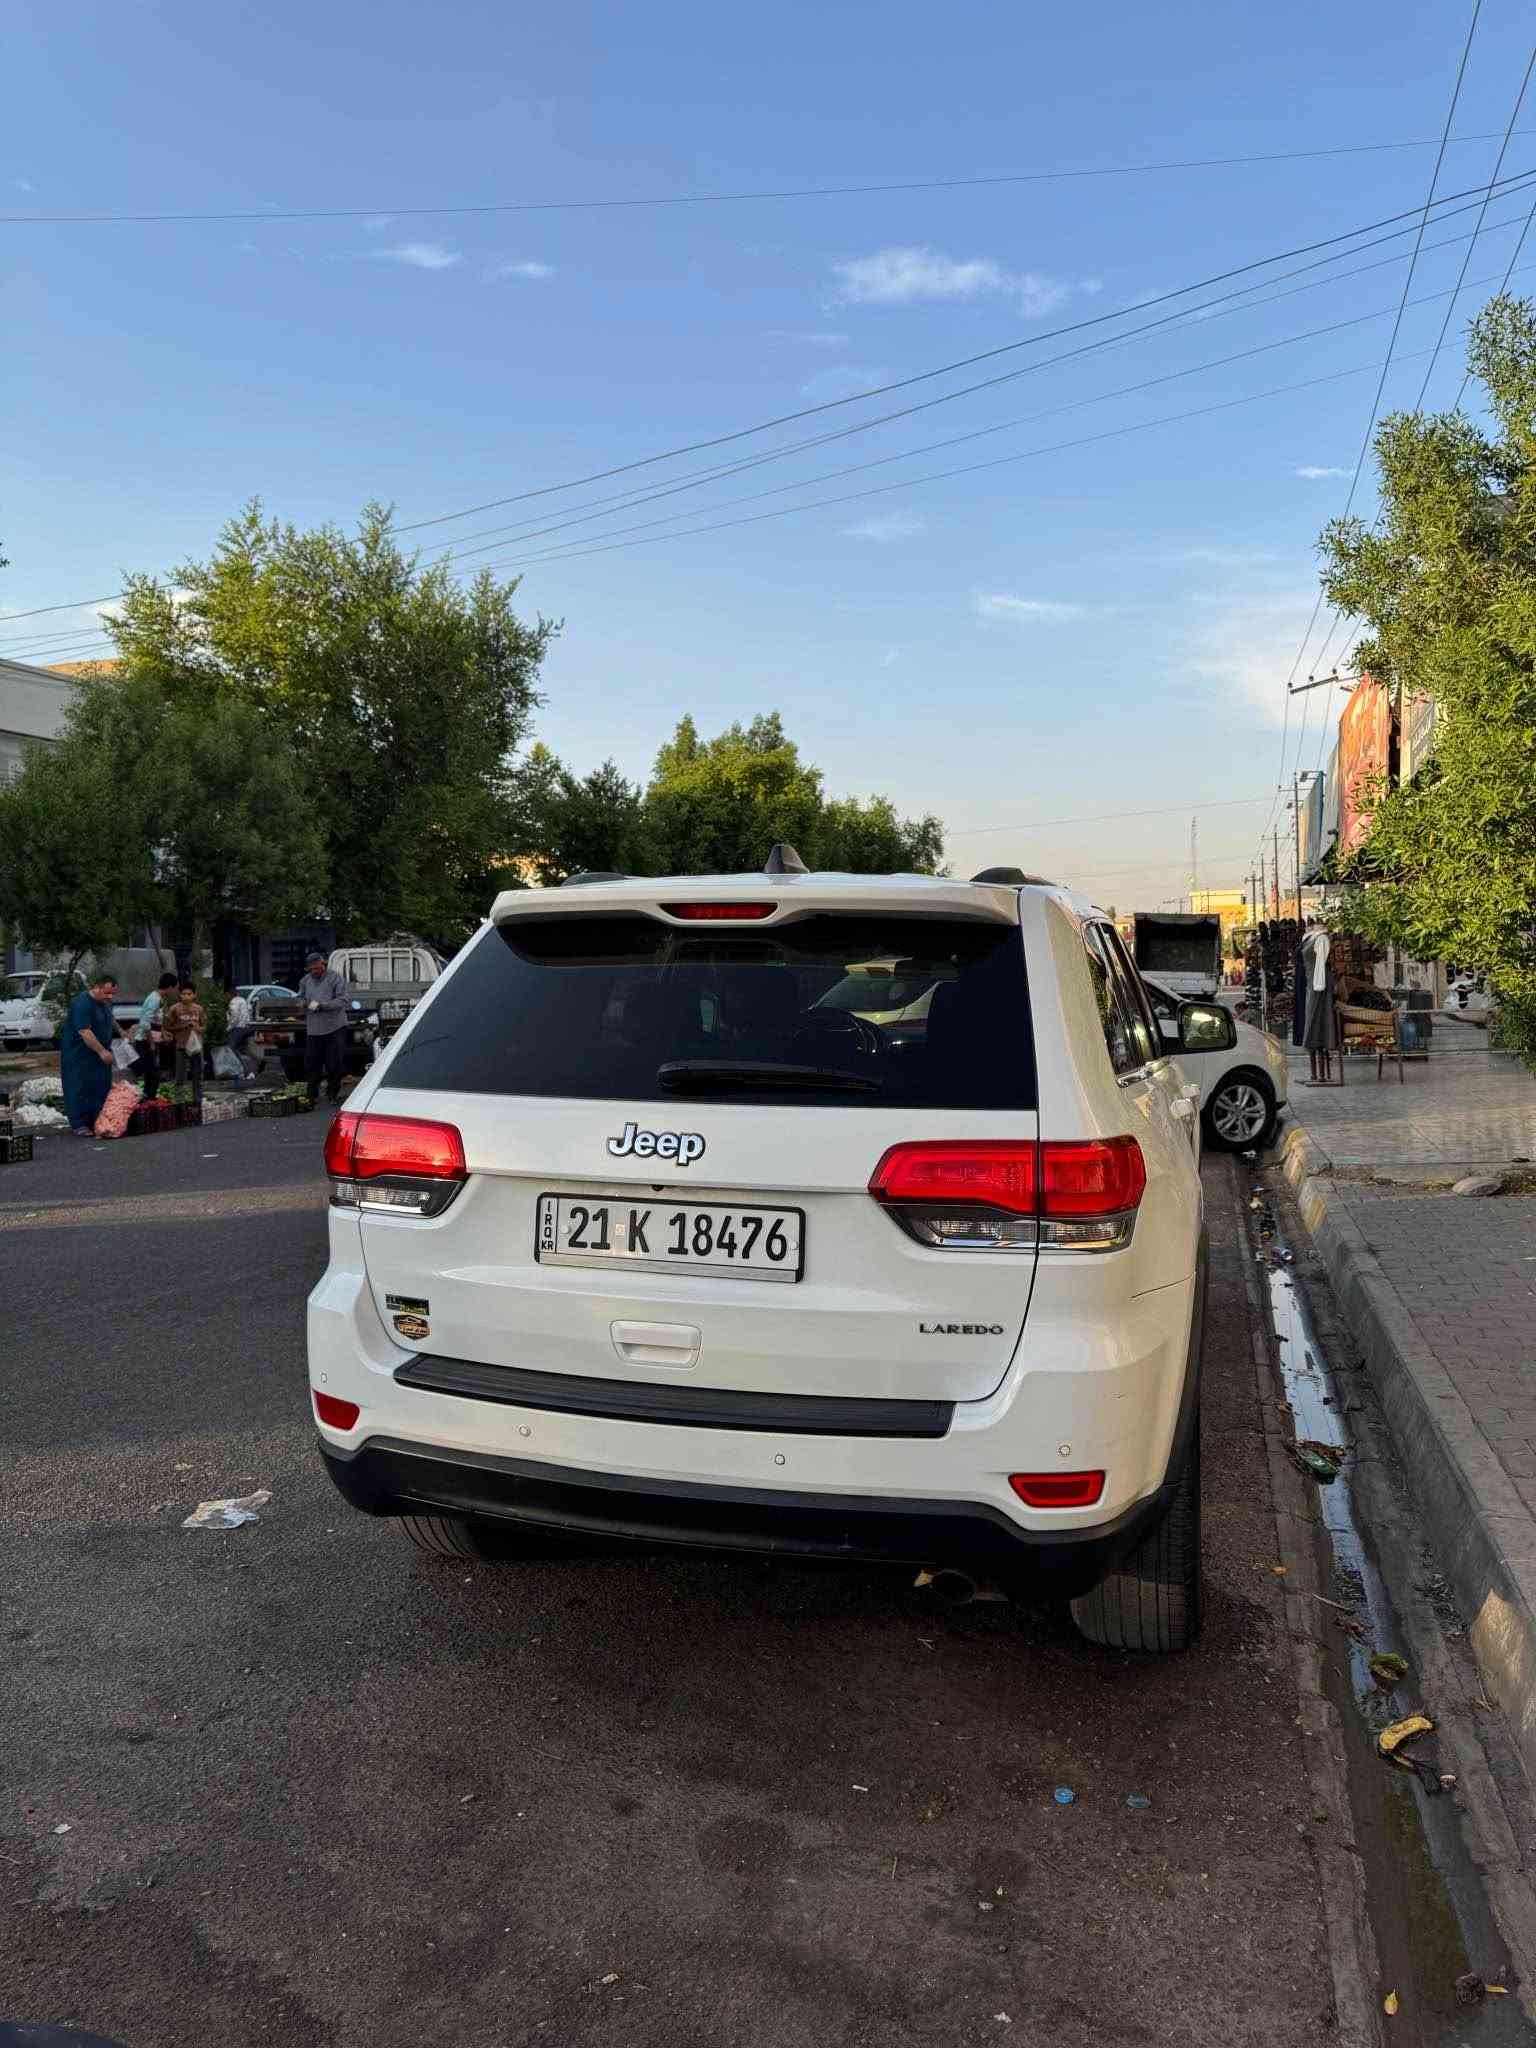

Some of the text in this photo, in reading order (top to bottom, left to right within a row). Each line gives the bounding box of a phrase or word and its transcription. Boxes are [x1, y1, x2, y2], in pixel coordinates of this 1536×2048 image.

[607, 1121, 705, 1166] Jeep
[541, 1240, 554, 1251] KR
[568, 1206, 788, 1262] 21 K 18476
[919, 1323, 1004, 1335] LAREDO
